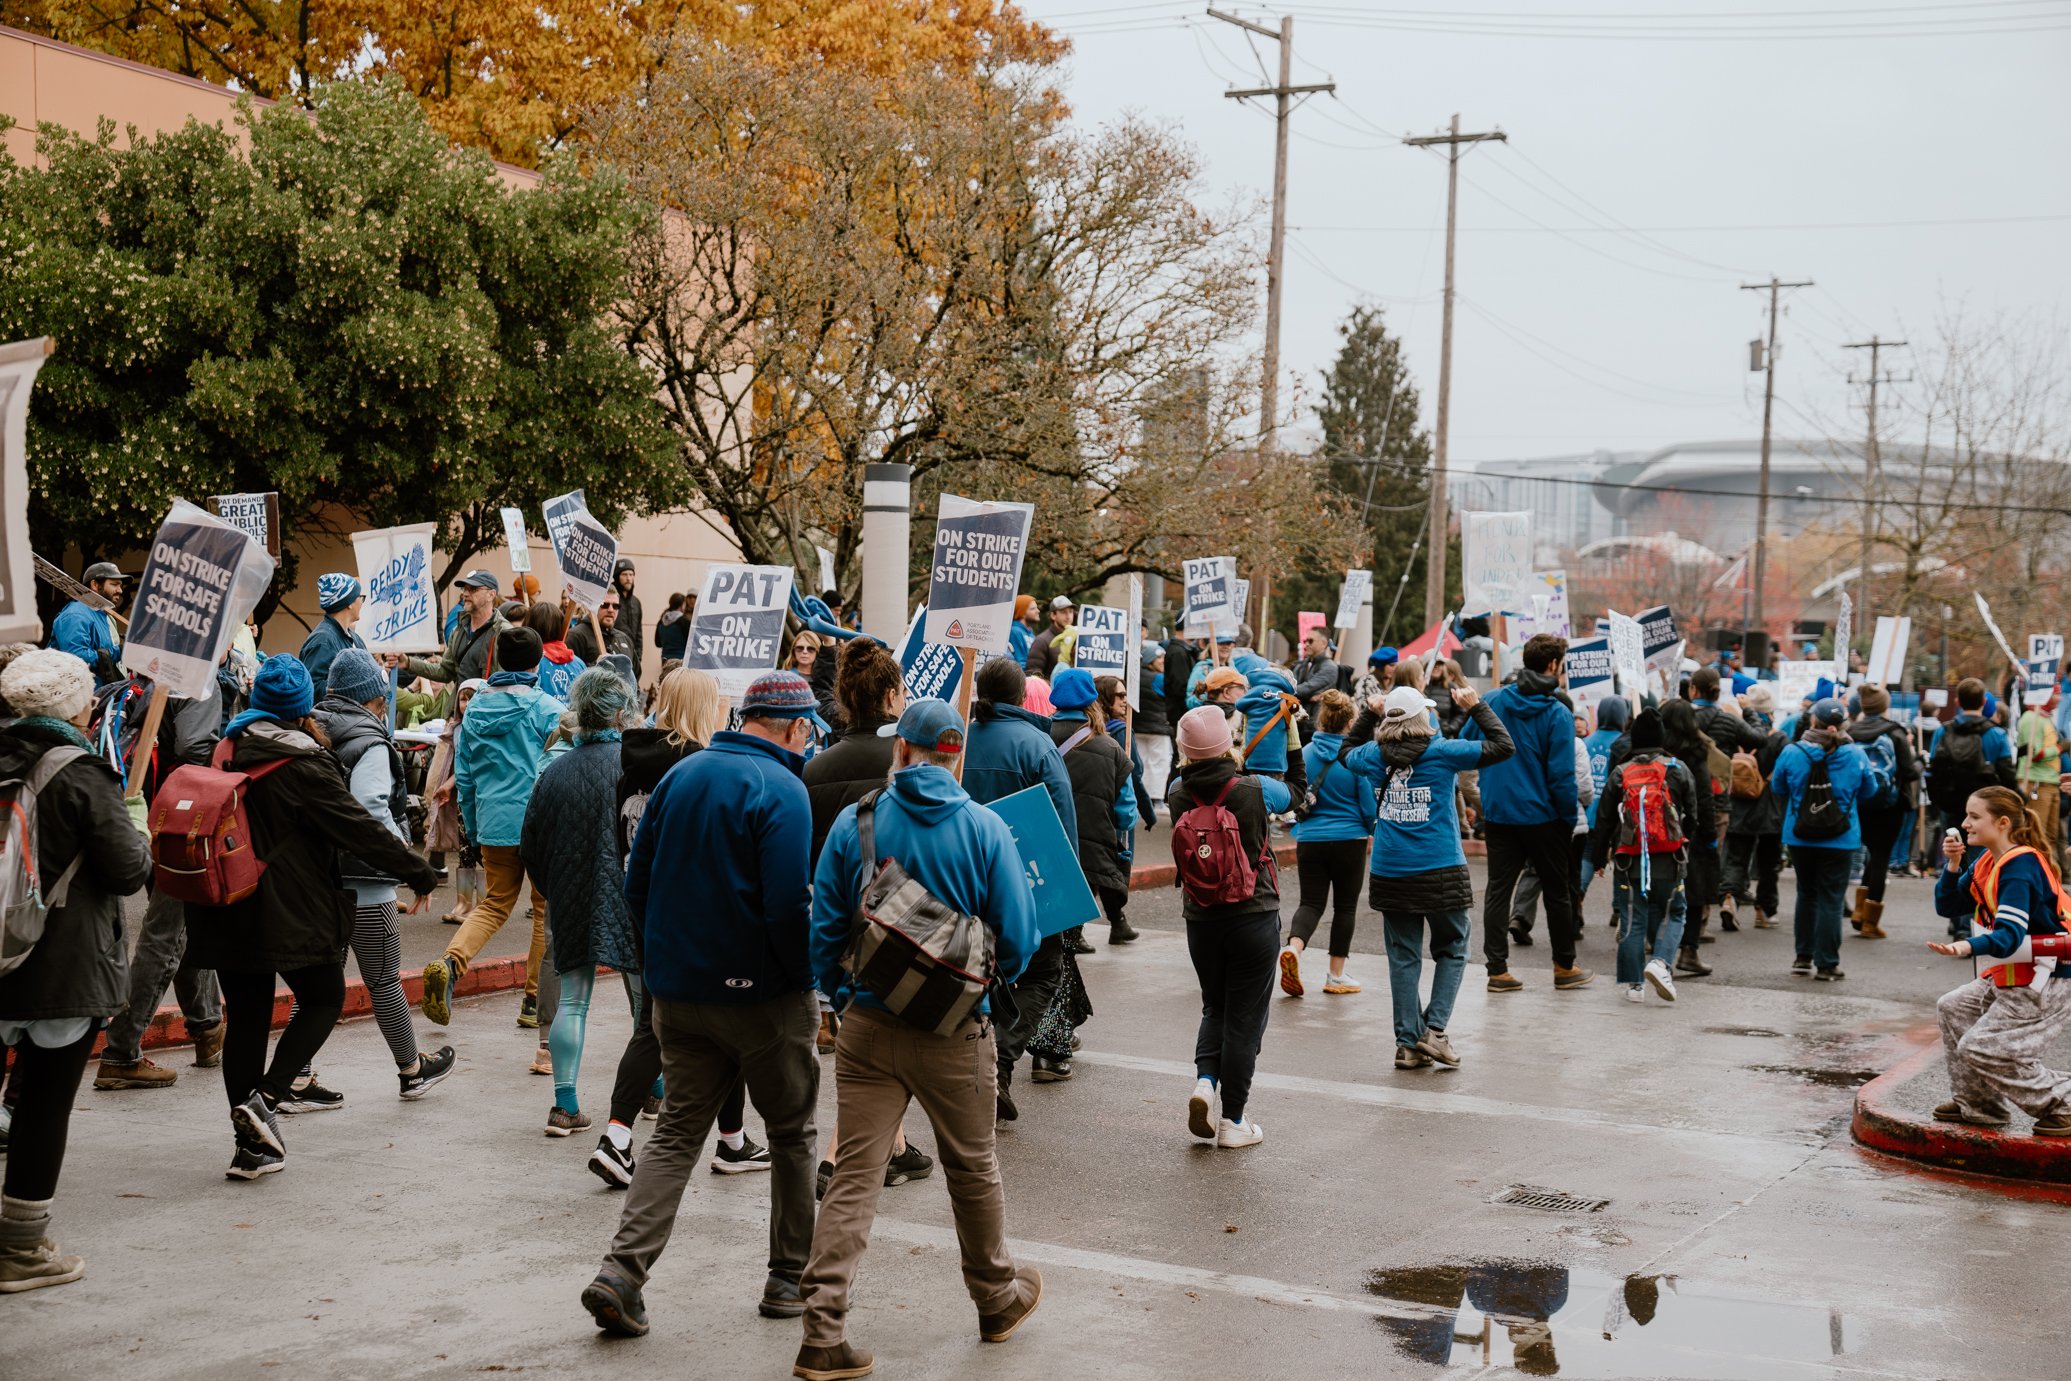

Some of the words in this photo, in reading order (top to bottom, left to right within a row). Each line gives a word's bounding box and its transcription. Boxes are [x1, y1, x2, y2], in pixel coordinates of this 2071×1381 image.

[219, 503, 265, 517] GREAT
[549, 516, 561, 527] ON
[554, 526, 570, 538] FOR
[937, 528, 963, 548] ON
[965, 531, 1020, 554] STRIKE
[571, 526, 584, 542] ON
[583, 535, 614, 563] STRIKE
[572, 539, 589, 558] FOR
[589, 552, 609, 571] OUR
[154, 542, 181, 569] ON
[181, 552, 232, 592] STRIKE
[565, 547, 609, 582] STUDENTS
[945, 548, 978, 568] FOR
[981, 553, 1012, 572] OUR
[1189, 561, 1219, 580] PAT
[370, 552, 410, 599] READY
[934, 565, 1014, 591] STUDENTS
[150, 568, 186, 594] FOR
[183, 580, 222, 615] SAFE
[708, 571, 782, 607] PAT
[1190, 590, 1226, 606] STRIKE
[1198, 582, 1213, 594] ON
[145, 593, 213, 638] SCHOOLS
[372, 593, 428, 640] STRIKE
[721, 616, 752, 637] ON
[967, 622, 992, 630] PORTLAND
[1082, 607, 1123, 631] PAT
[1091, 635, 1110, 650] ON
[1652, 625, 1672, 637] OUR
[697, 635, 773, 659] STRIKE
[1078, 645, 1123, 664] STRIKE
[1567, 652, 1578, 662] ON
[1580, 649, 1610, 661] STRIKE
[914, 669, 933, 698] FOR
[928, 644, 950, 674] SAFE
[1568, 667, 1611, 679] STUDENTS
[1571, 660, 1588, 669] FOR
[1589, 658, 1608, 667] OUR
[905, 664, 919, 687] ON
[926, 654, 957, 698] CHOOLS
[1389, 790, 1410, 804] TIME
[1412, 789, 1432, 802] FOR
